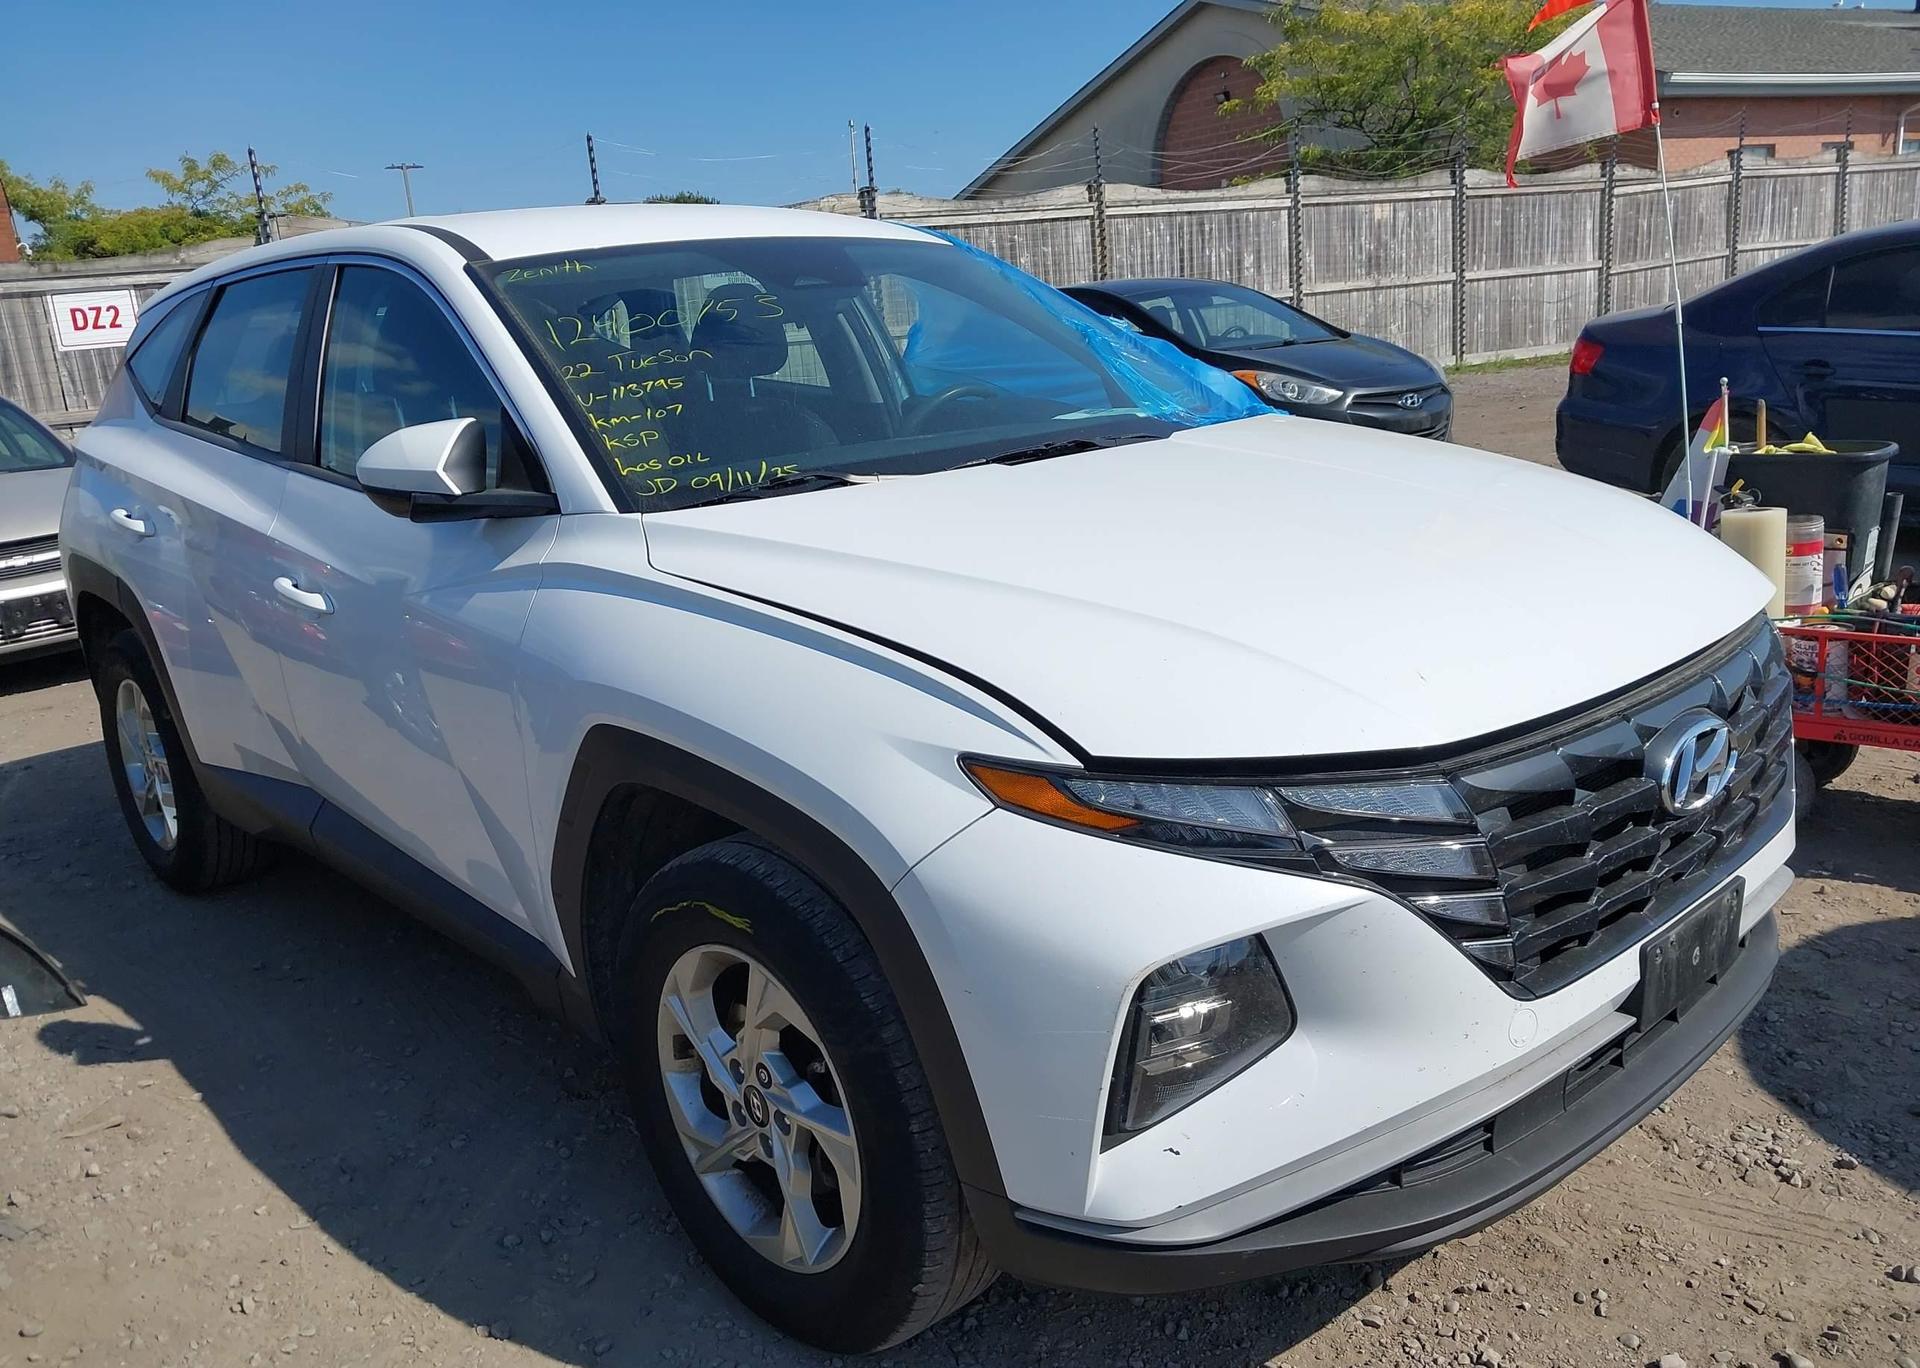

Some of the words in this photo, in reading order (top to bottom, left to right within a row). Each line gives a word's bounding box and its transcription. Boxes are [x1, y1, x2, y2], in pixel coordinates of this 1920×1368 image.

[69, 304, 122, 331] DZ2
[544, 294, 785, 352] 12400153
[560, 362, 606, 380] 22
[635, 477, 678, 497] JD
[1849, 733, 1900, 746] GORILLA
